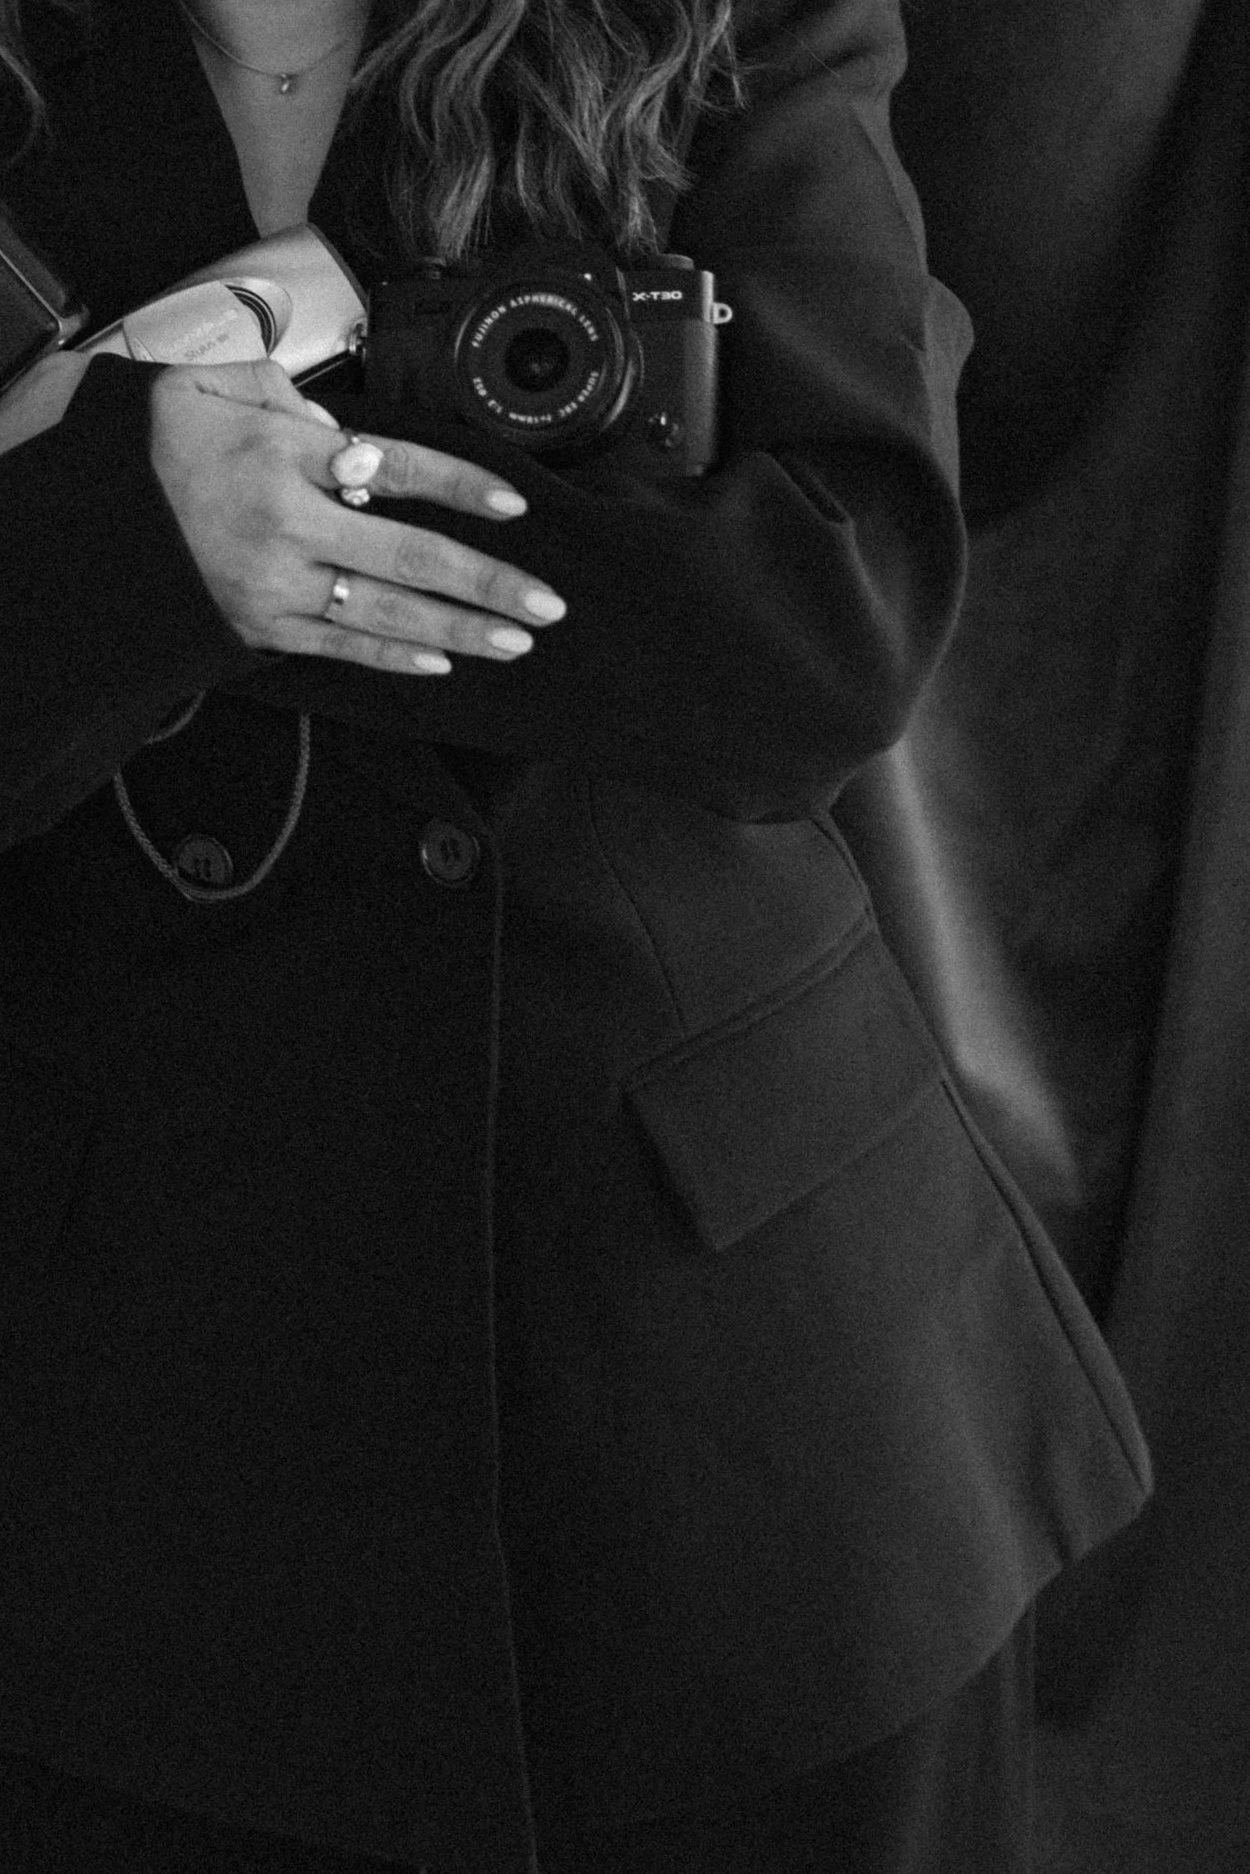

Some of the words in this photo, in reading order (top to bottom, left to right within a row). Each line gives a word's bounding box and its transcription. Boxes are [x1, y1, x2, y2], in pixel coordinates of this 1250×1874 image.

[632, 290, 683, 302] X-T30
[472, 305, 507, 348] FUJINON
[510, 292, 579, 316] ASPHERICAL
[579, 314, 599, 342] LENS
